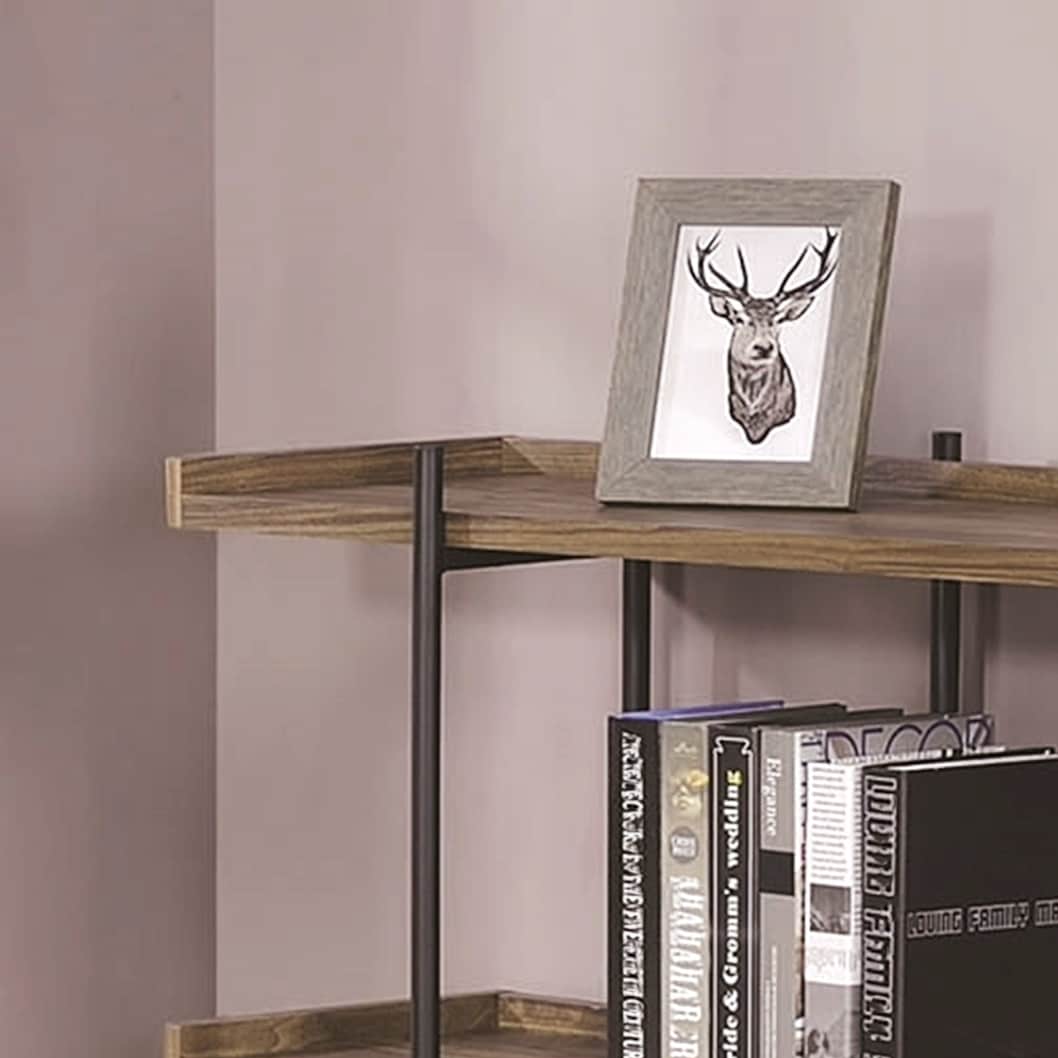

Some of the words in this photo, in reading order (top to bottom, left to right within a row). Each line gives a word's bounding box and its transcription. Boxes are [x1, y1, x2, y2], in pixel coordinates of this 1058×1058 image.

[723, 769, 744, 868] wedding
[761, 757, 782, 837] Elegance
[723, 989, 738, 1011] &
